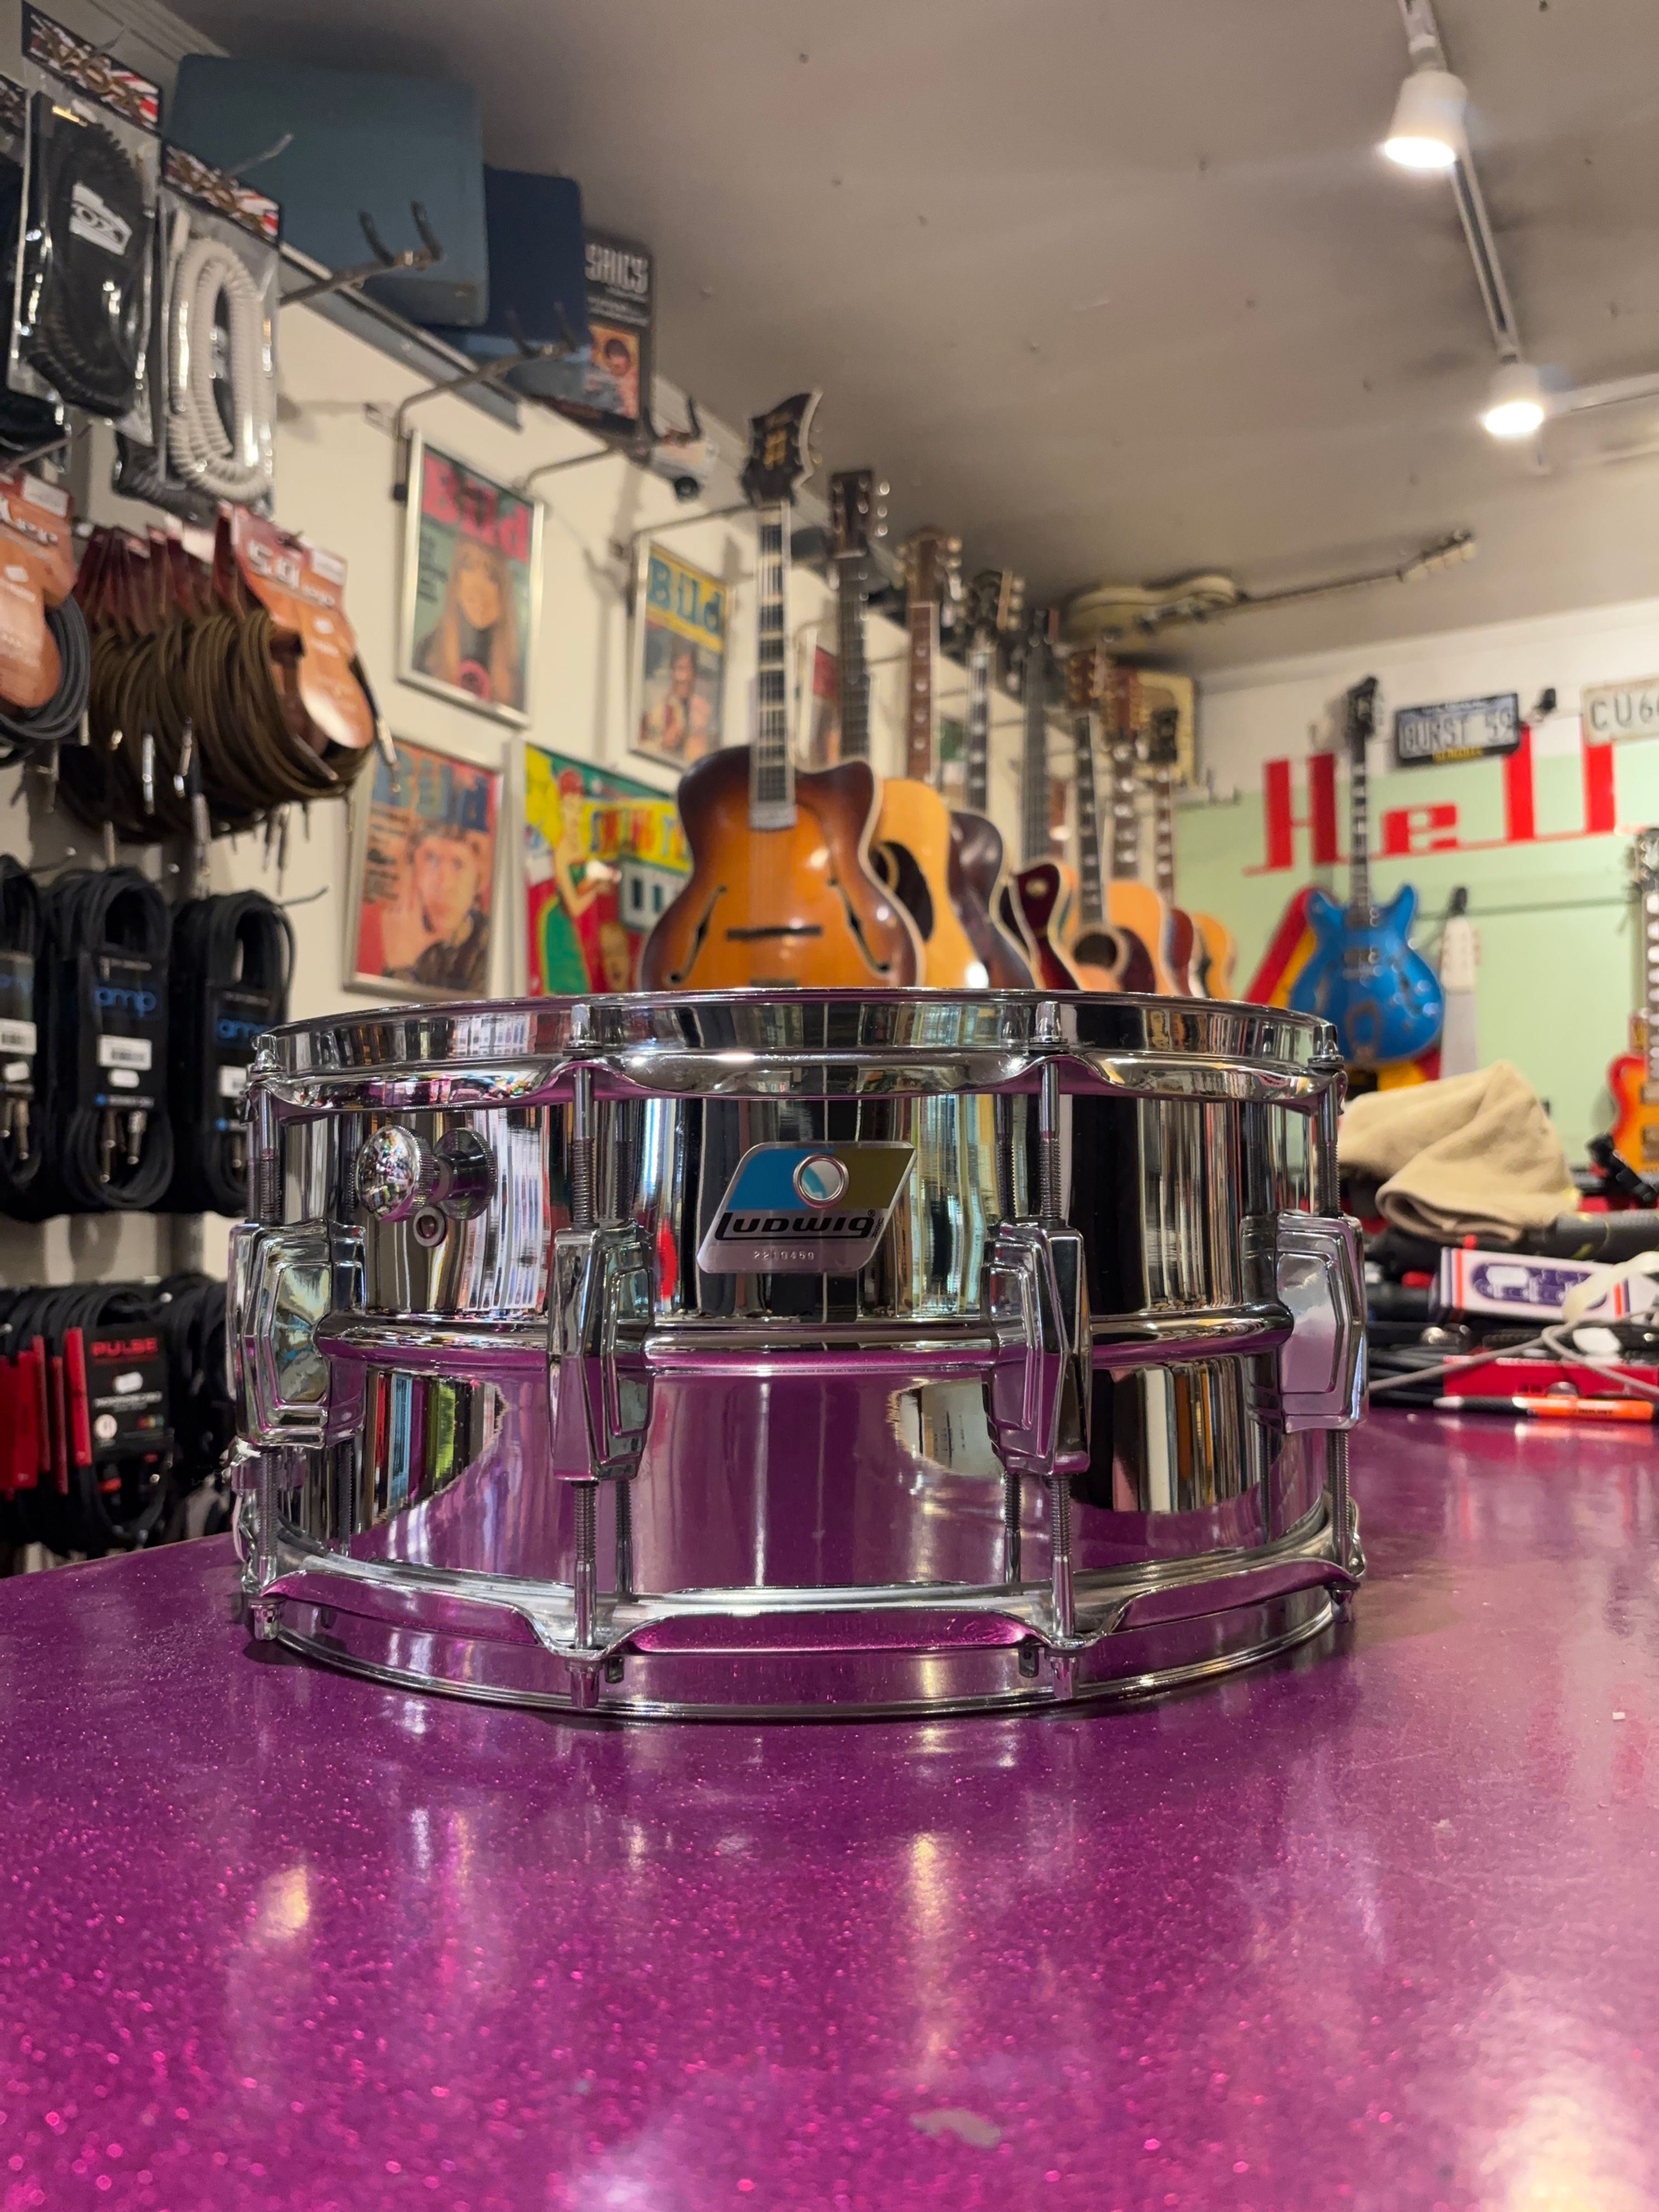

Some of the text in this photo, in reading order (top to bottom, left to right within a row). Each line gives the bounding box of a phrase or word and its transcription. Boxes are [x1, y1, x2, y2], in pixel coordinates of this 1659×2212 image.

[648, 556, 722, 636] Bild
[1589, 692, 1659, 731] CU6
[1401, 716, 1468, 757] BURST
[753, 1250, 815, 1261] 2219459
[91, 1338, 159, 1357] PULSE
